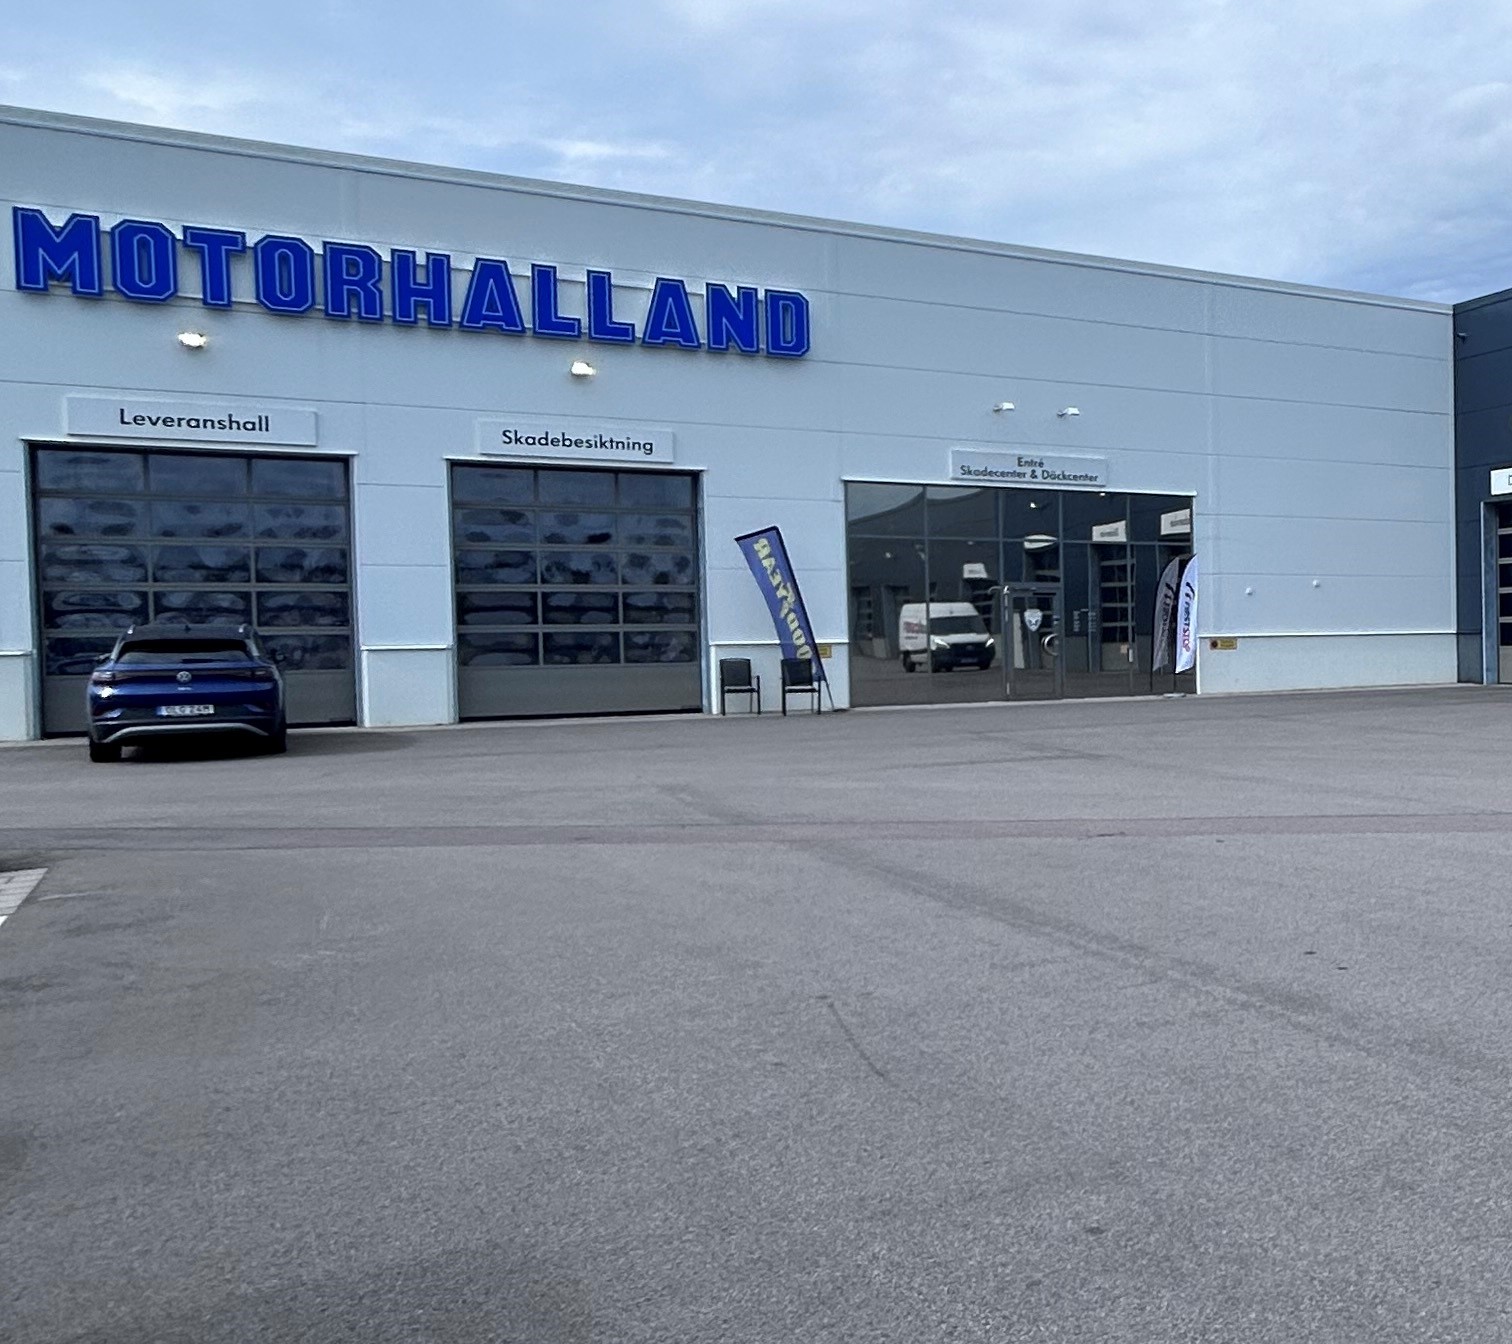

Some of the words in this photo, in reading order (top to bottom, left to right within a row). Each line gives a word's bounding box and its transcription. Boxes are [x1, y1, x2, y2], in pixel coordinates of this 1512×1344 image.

[12, 206, 811, 359] MOTORHALLAND
[119, 408, 270, 432] Leveranshall
[502, 429, 654, 455] Skadebesiktning
[960, 465, 1027, 479] Skadecenter
[1030, 469, 1038, 480] &
[1041, 469, 1099, 482] Däckcenter
[1017, 457, 1045, 468] Entré
